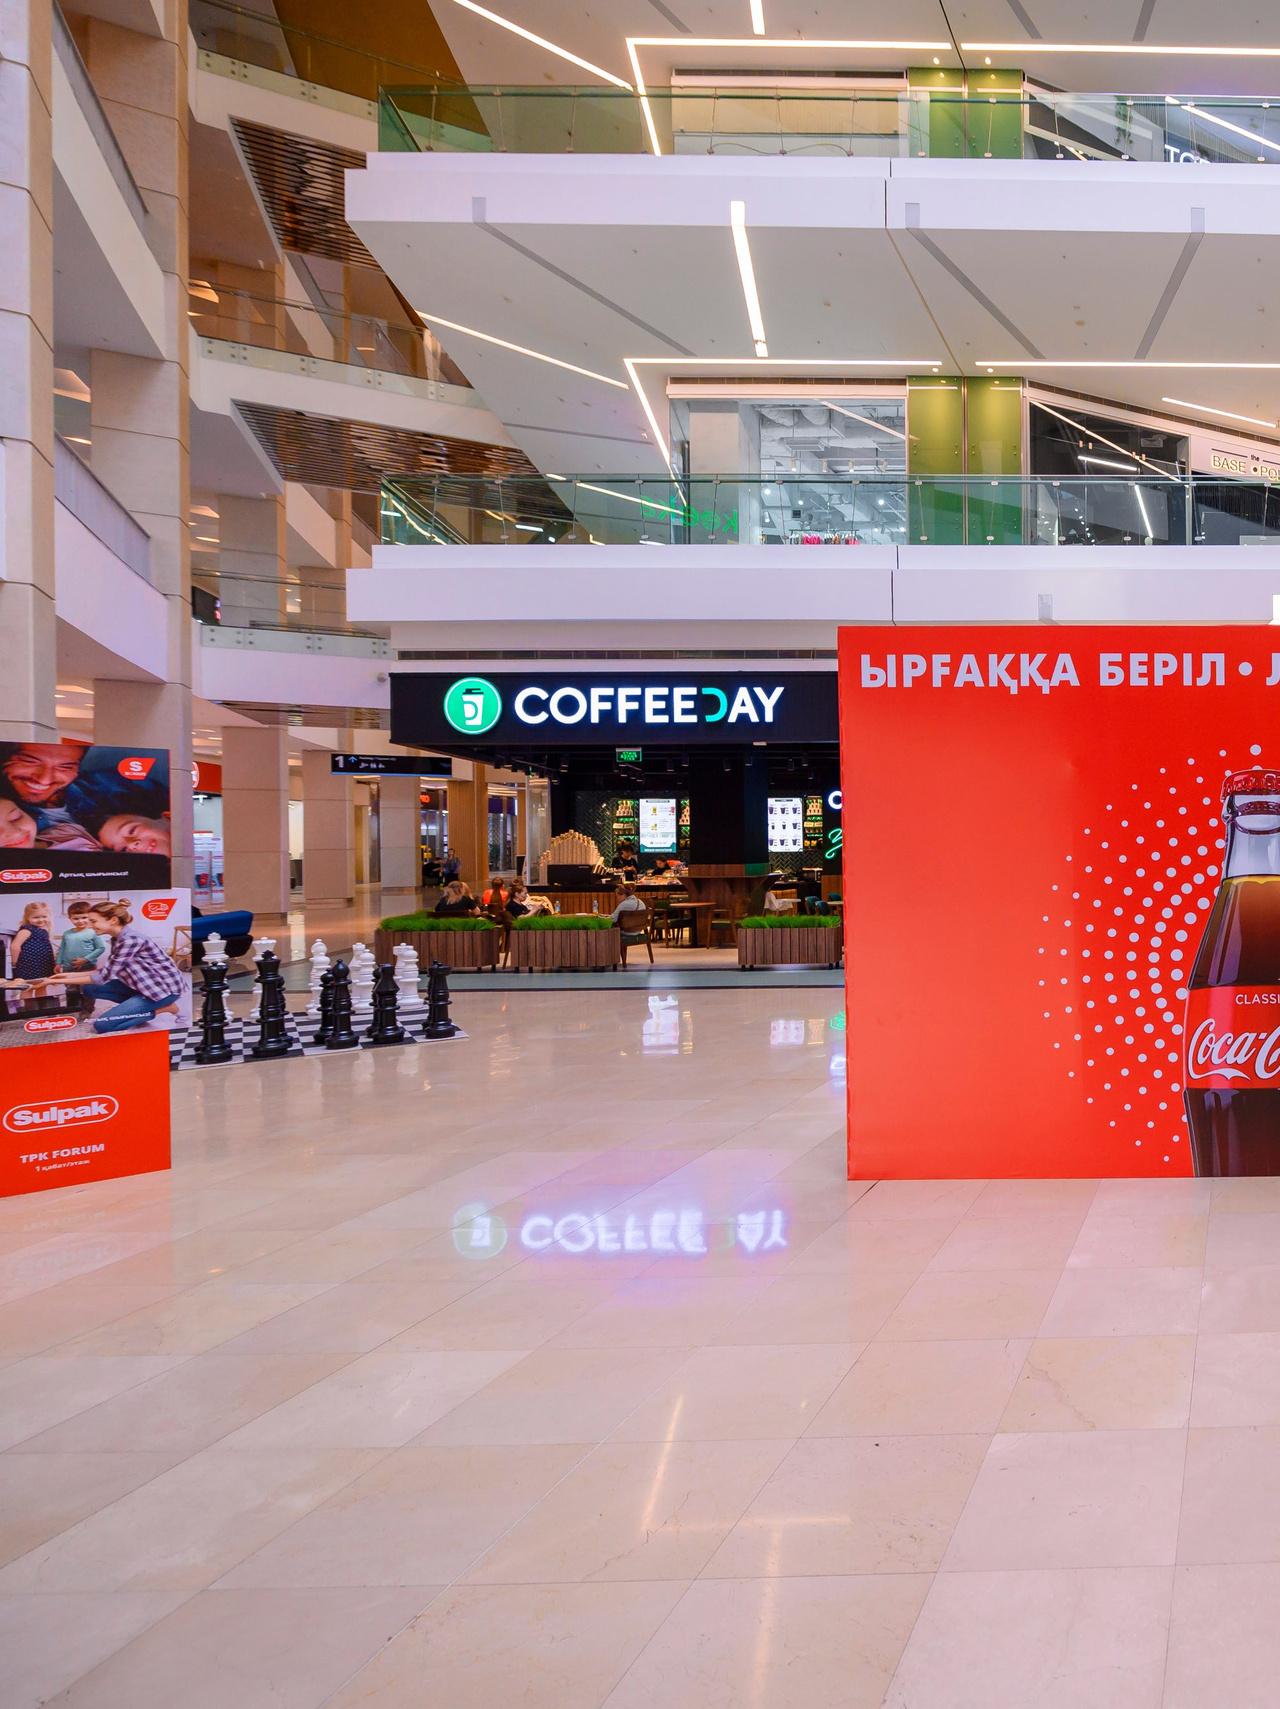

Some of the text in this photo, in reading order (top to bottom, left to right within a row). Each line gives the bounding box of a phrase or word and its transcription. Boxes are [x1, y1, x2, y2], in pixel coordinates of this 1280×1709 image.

[1212, 455, 1247, 474] BASE
[1250, 454, 1260, 462] the
[860, 653, 1081, 695] ЫРҒАҚҚА
[1099, 652, 1226, 687] БЕРІЛ
[335, 755, 344, 768] 1
[2, 871, 47, 882] Sulpak
[27, 1017, 73, 1030] Sulpak
[13, 1101, 109, 1126] Sulpak
[52, 1143, 105, 1159] FORUM
